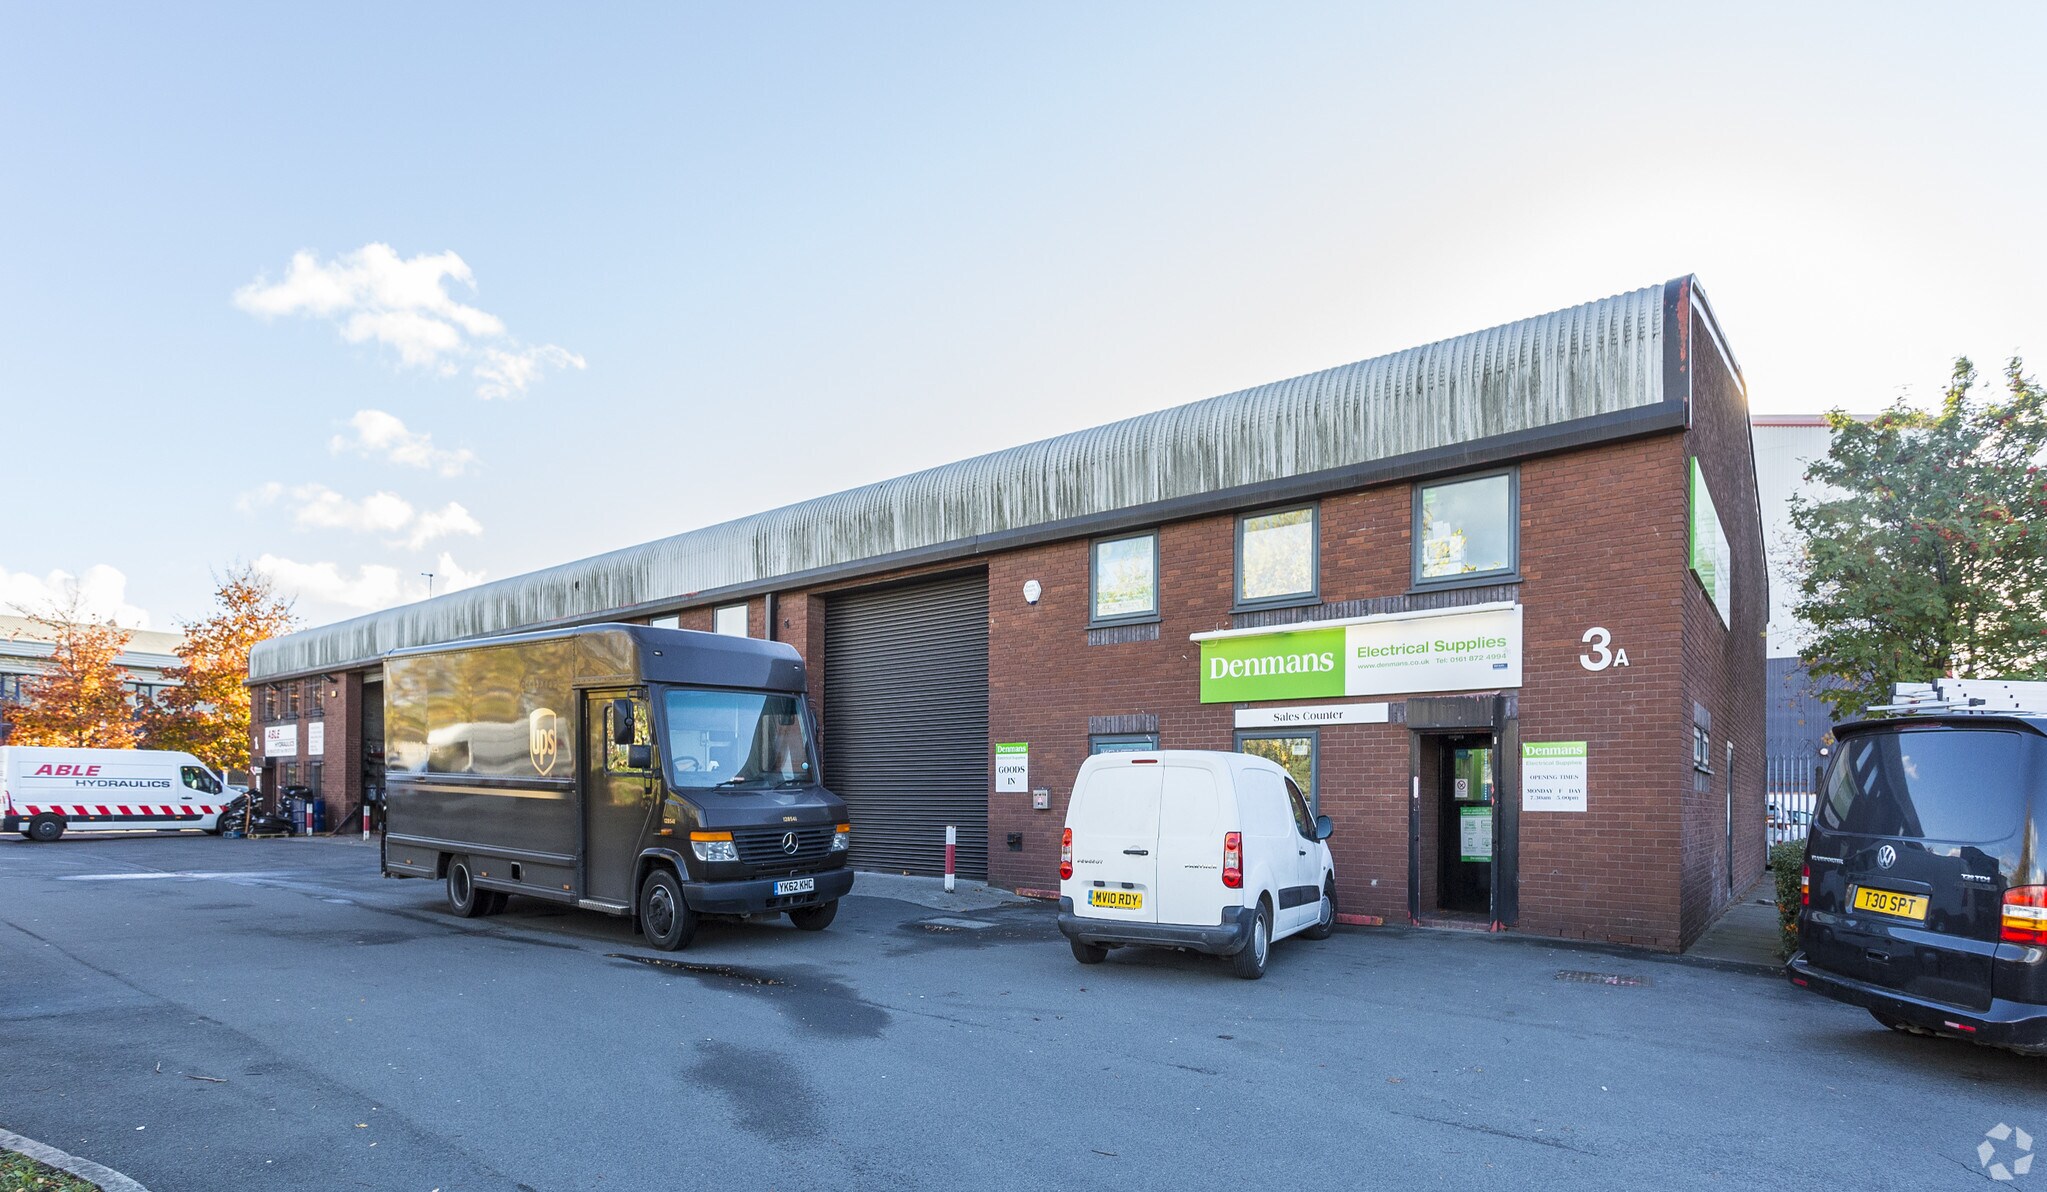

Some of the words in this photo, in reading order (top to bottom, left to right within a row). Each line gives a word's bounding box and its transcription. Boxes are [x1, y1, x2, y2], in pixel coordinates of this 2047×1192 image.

[1357, 641, 1429, 658] Electrical
[1434, 636, 1507, 653] Supplies
[1209, 651, 1335, 680] Denmans
[1357, 658, 1430, 670] www.denmans.co.uk
[1469, 654, 1484, 662] 872
[1273, 712, 1300, 722] Sales
[1302, 711, 1344, 721] Counter
[532, 728, 555, 765] ups
[997, 745, 1027, 753] Denmans
[1526, 746, 1583, 756] Denmans
[34, 764, 102, 777] ABLE
[998, 766, 1026, 774] GOODS
[76, 779, 171, 788] HYDRAULICS
[1007, 777, 1016, 785] IN
[778, 881, 798, 893] YK62
[799, 879, 813, 890] KHC
[1095, 891, 1117, 904] MV10
[1118, 893, 1139, 906] RDY
[1865, 892, 1887, 909] T30
[1889, 896, 1917, 914] SPT
